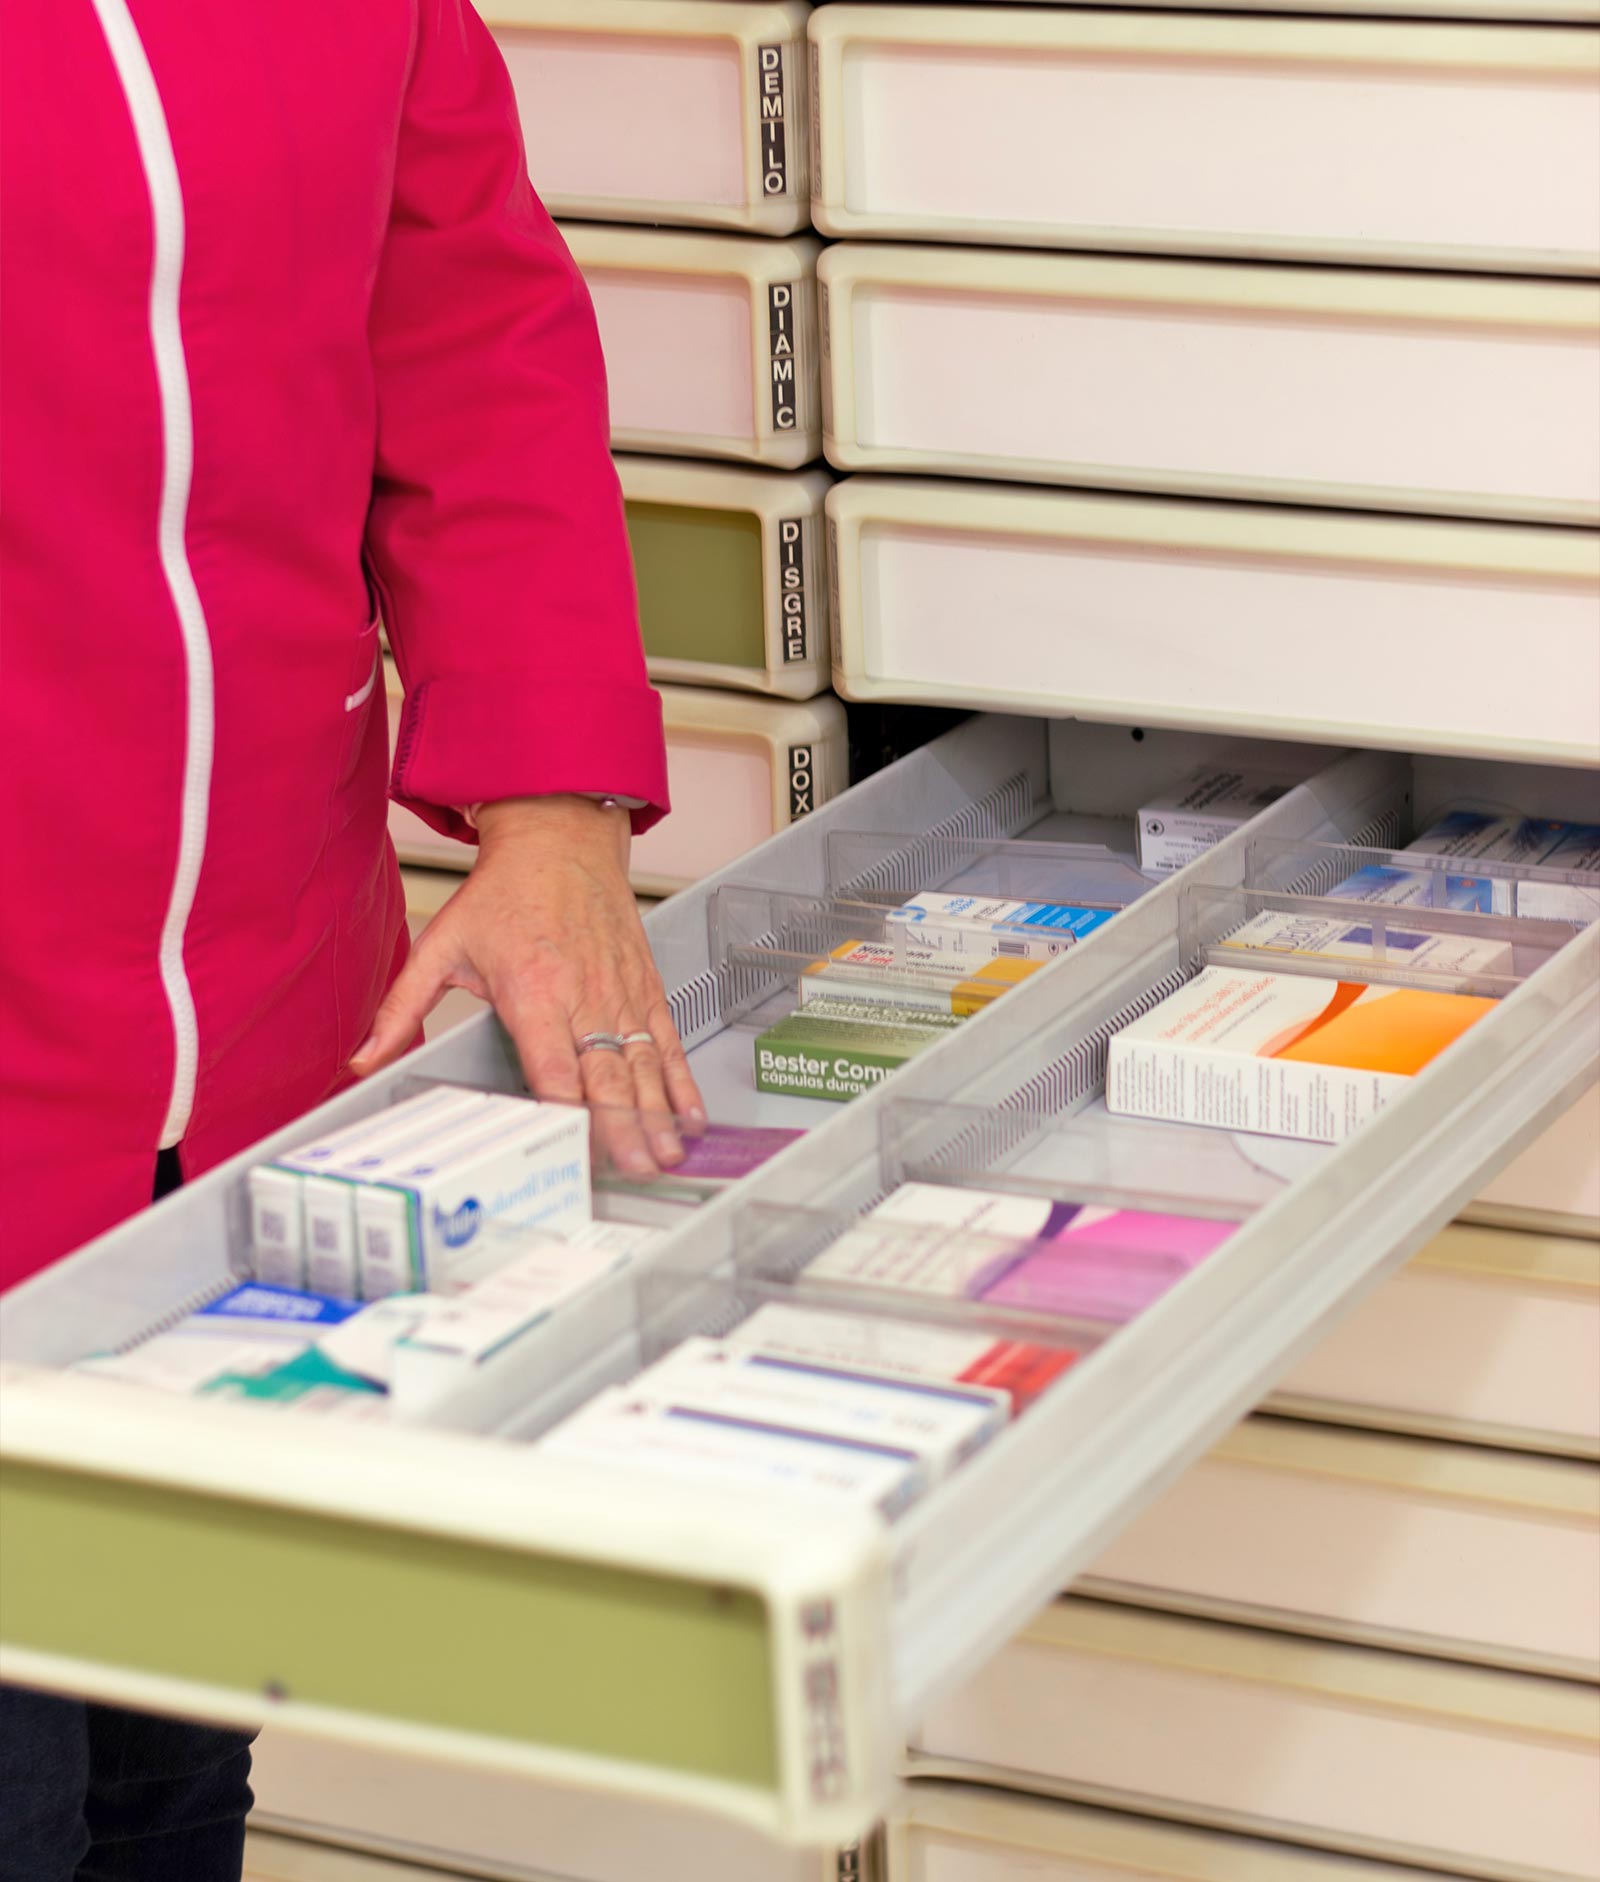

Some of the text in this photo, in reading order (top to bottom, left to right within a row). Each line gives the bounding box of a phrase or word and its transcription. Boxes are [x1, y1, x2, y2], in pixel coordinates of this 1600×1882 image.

[761, 48, 784, 194] DEMILO
[772, 286, 794, 428] DIAMIC
[782, 521, 803, 660] DISGRE
[760, 1049, 829, 1076] Bester
[761, 1069, 824, 1089] cápsulas
